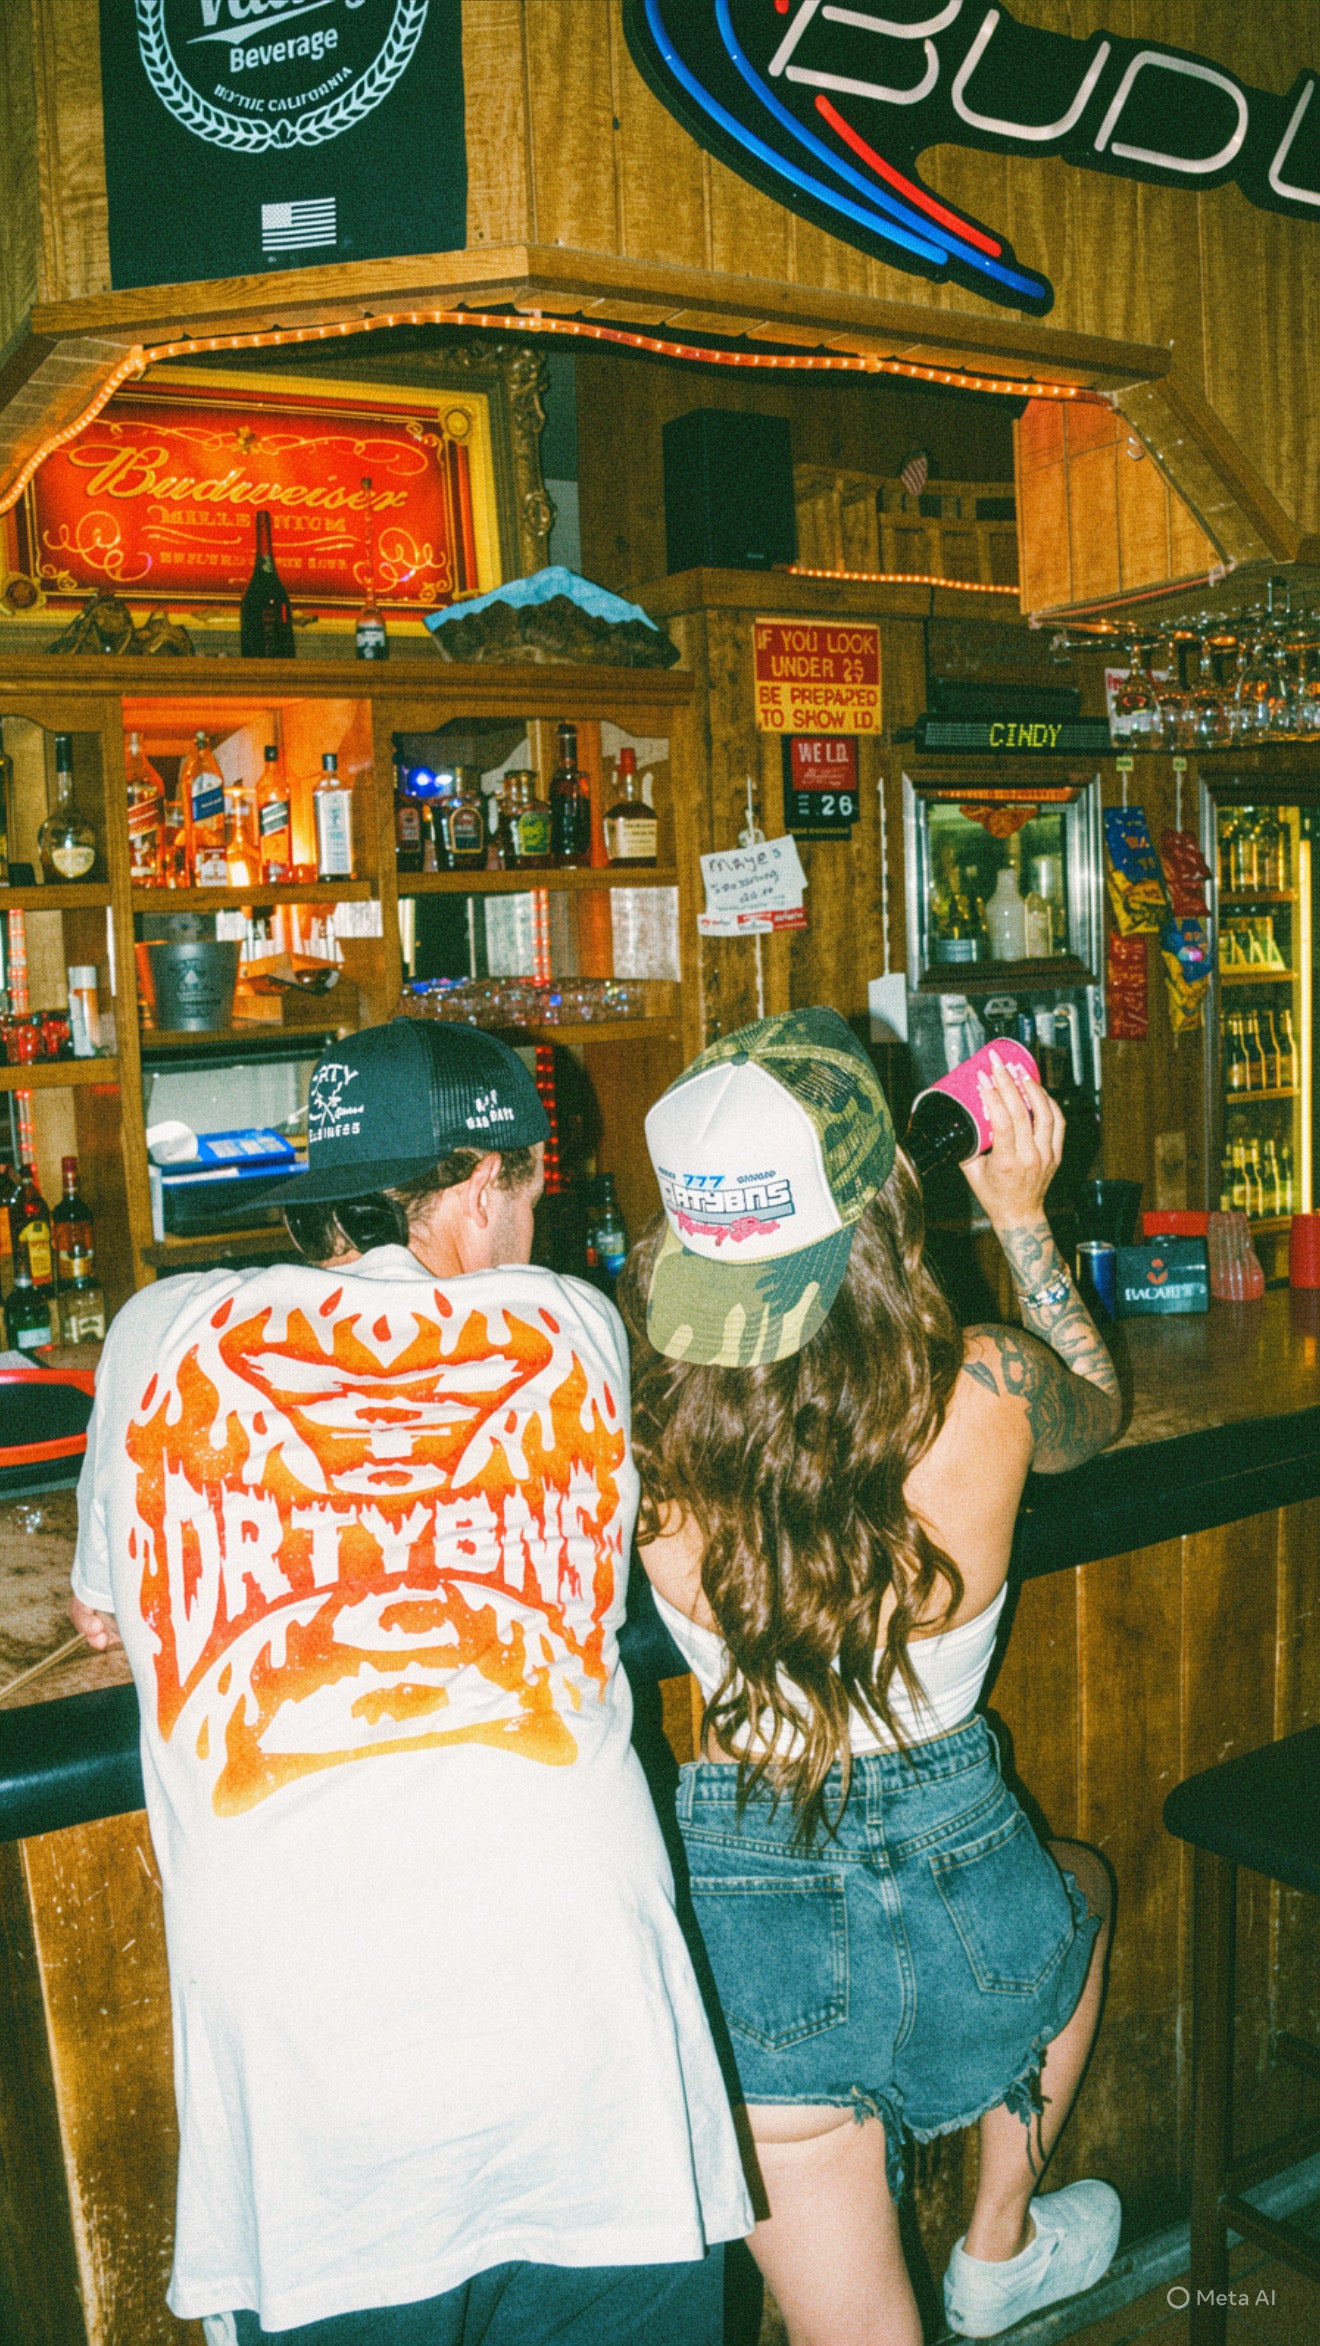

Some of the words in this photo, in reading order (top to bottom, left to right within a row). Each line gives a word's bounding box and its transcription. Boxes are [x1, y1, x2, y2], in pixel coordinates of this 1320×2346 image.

[229, 28, 338, 73] Beverage
[68, 443, 409, 511] Budweiser
[757, 629, 772, 649] IF
[781, 629, 818, 652] YOU
[826, 632, 875, 654] LOOK
[771, 655, 834, 677] UNDER
[759, 686, 781, 705] BE
[790, 687, 877, 706] PREPARED
[760, 708, 785, 728] TO
[792, 708, 846, 729] SHOW
[990, 722, 1062, 747] CINDY
[798, 742, 822, 763] WE
[312, 1063, 359, 1085] RTY
[683, 1173, 725, 1188] 777
